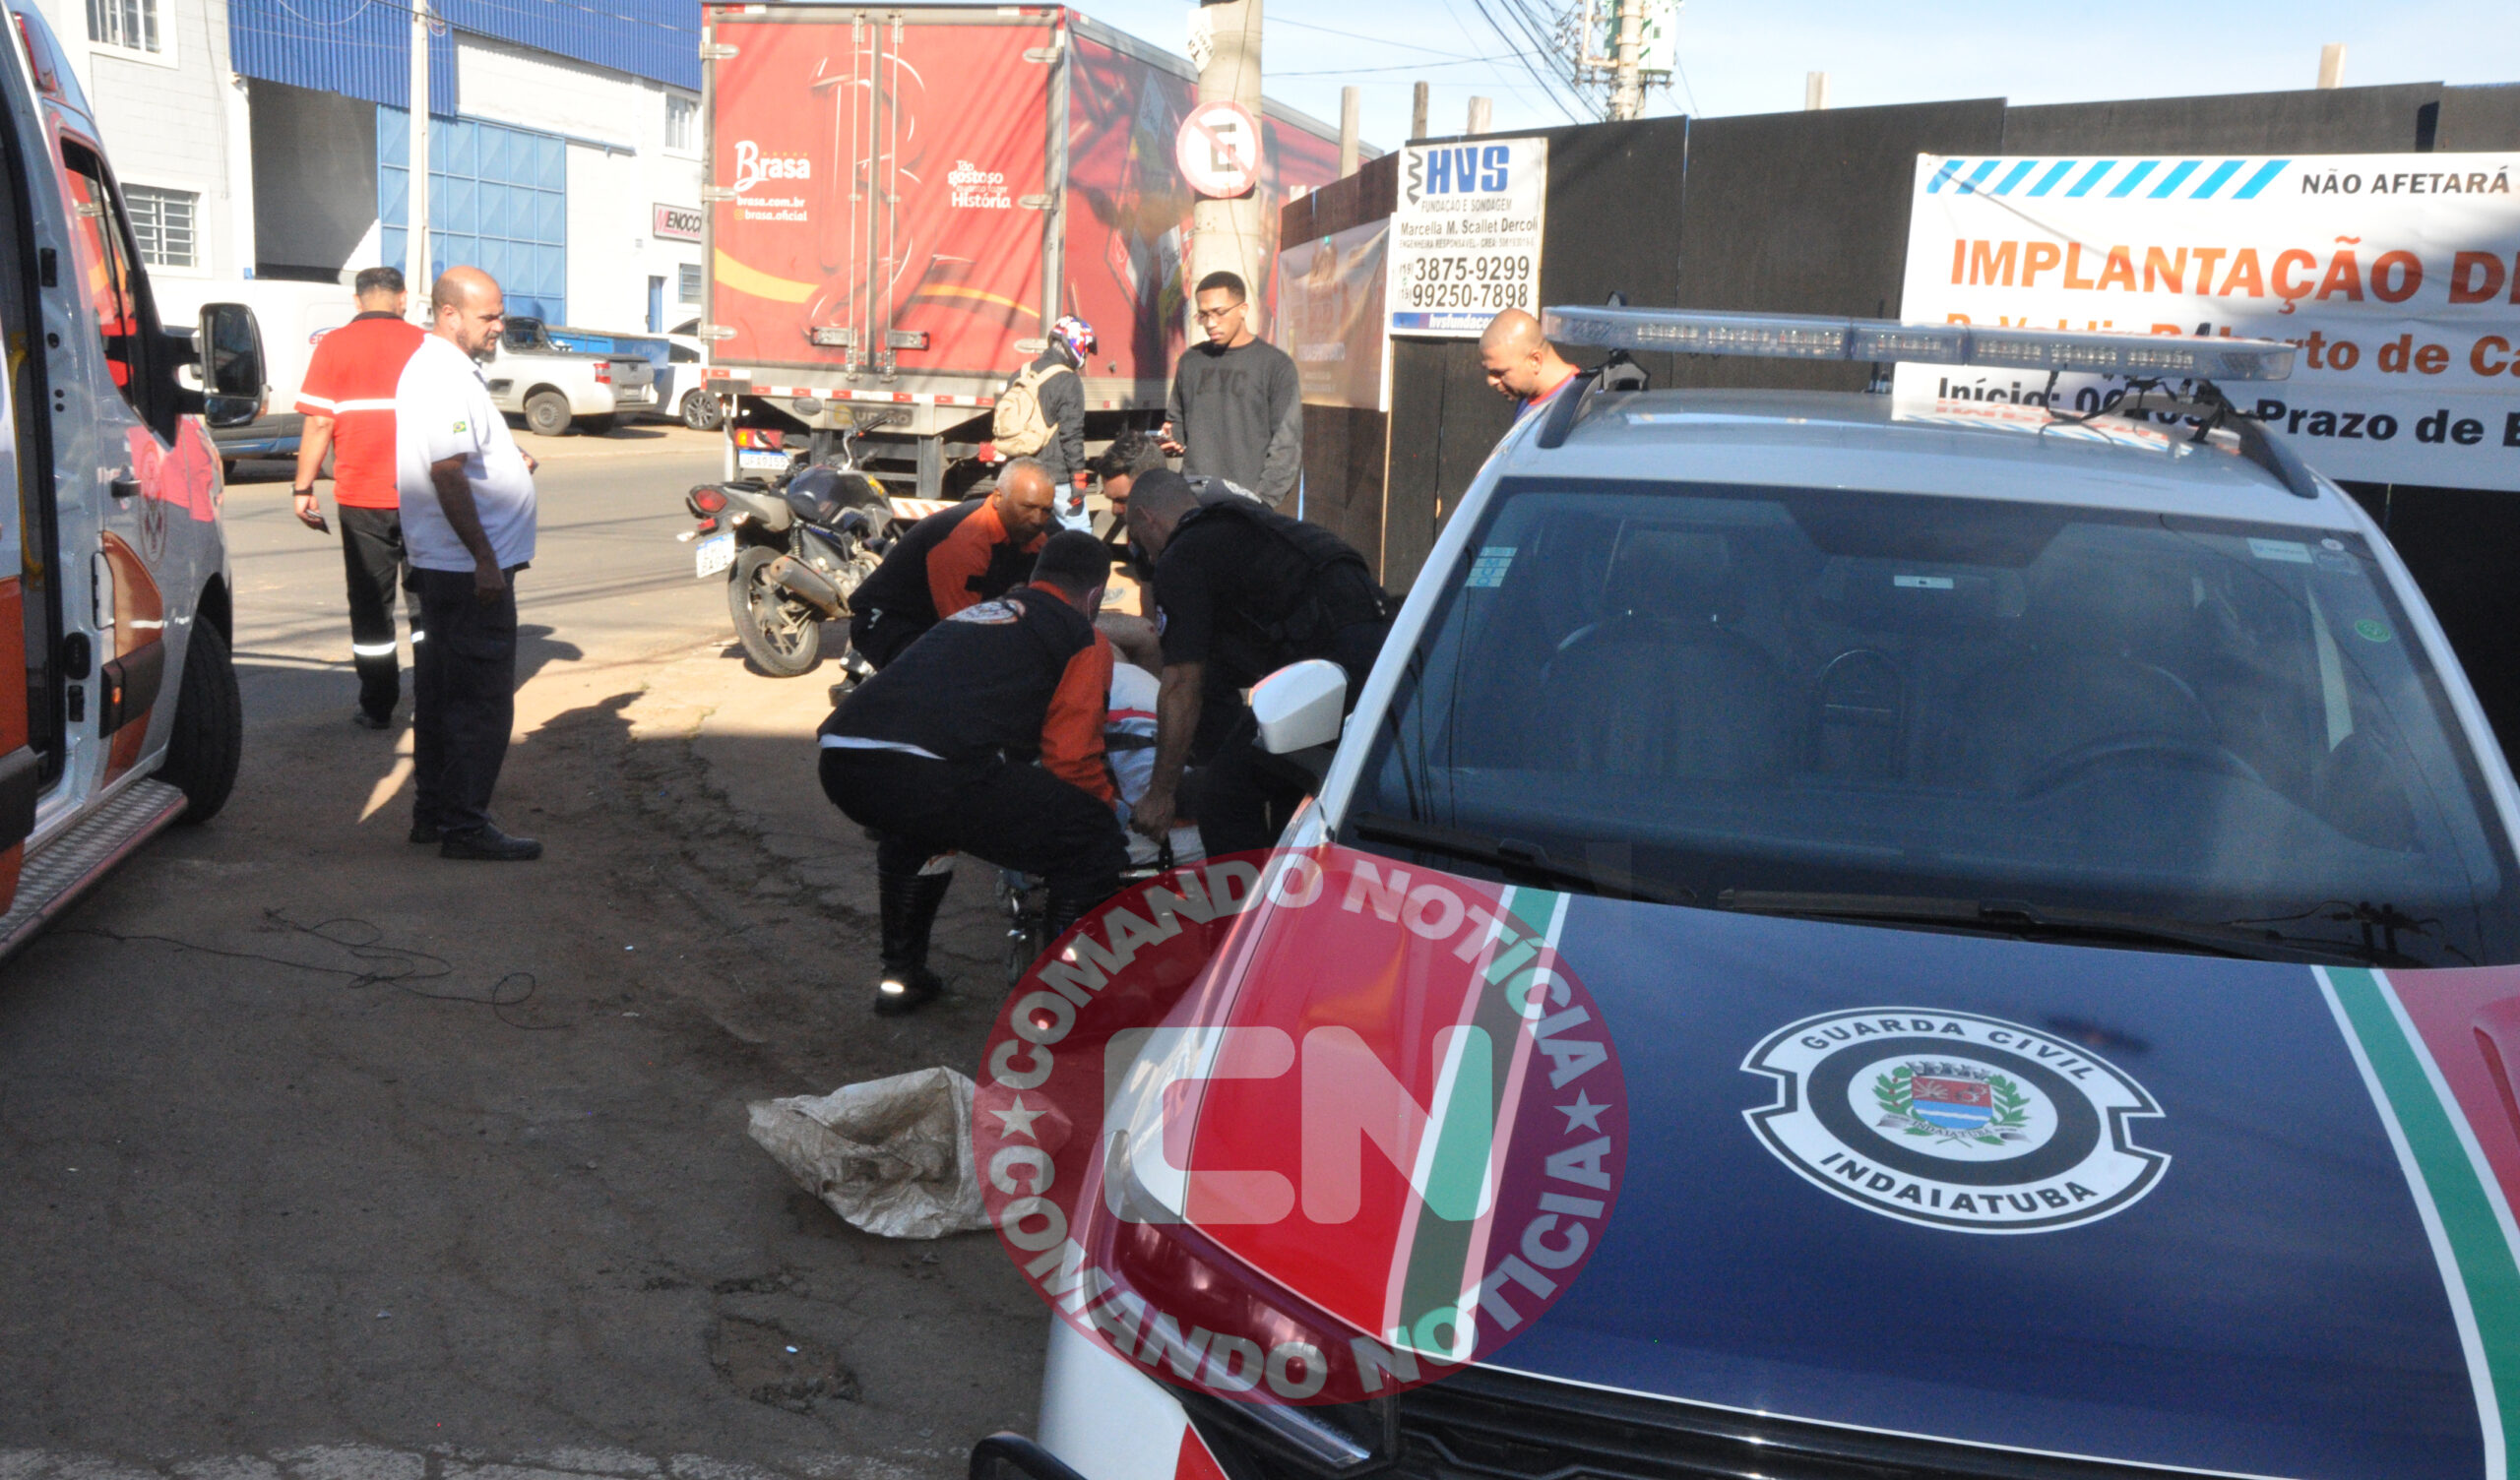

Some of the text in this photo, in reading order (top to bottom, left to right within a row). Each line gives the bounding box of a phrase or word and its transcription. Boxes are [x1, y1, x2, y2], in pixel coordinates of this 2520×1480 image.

[1211, 123, 1238, 172] E
[733, 140, 810, 192] Brasa
[948, 170, 1004, 187] gostoso
[1425, 146, 1510, 194] HVS
[2300, 165, 2511, 195] NÃO AFETARÁ
[736, 196, 805, 208] brasa.com.br
[951, 192, 1012, 209] História
[1463, 199, 1469, 211] E
[1471, 198, 1513, 213] SONDAGEM
[1400, 221, 1442, 236] Marcella
[1446, 220, 1459, 235] M.
[1461, 217, 1498, 235] Scallet
[1415, 255, 1531, 281] 3875-9299
[1951, 234, 2424, 315] IMPLANTAÇÃO
[1412, 282, 1530, 308] 99250-7898
[2378, 334, 2450, 375] de
[2256, 399, 2399, 441] Prazo
[2415, 409, 2486, 447] de
[1799, 1018, 2099, 1080] GUARDA CIVIL
[1819, 1151, 2099, 1215] INDAIATUBA
